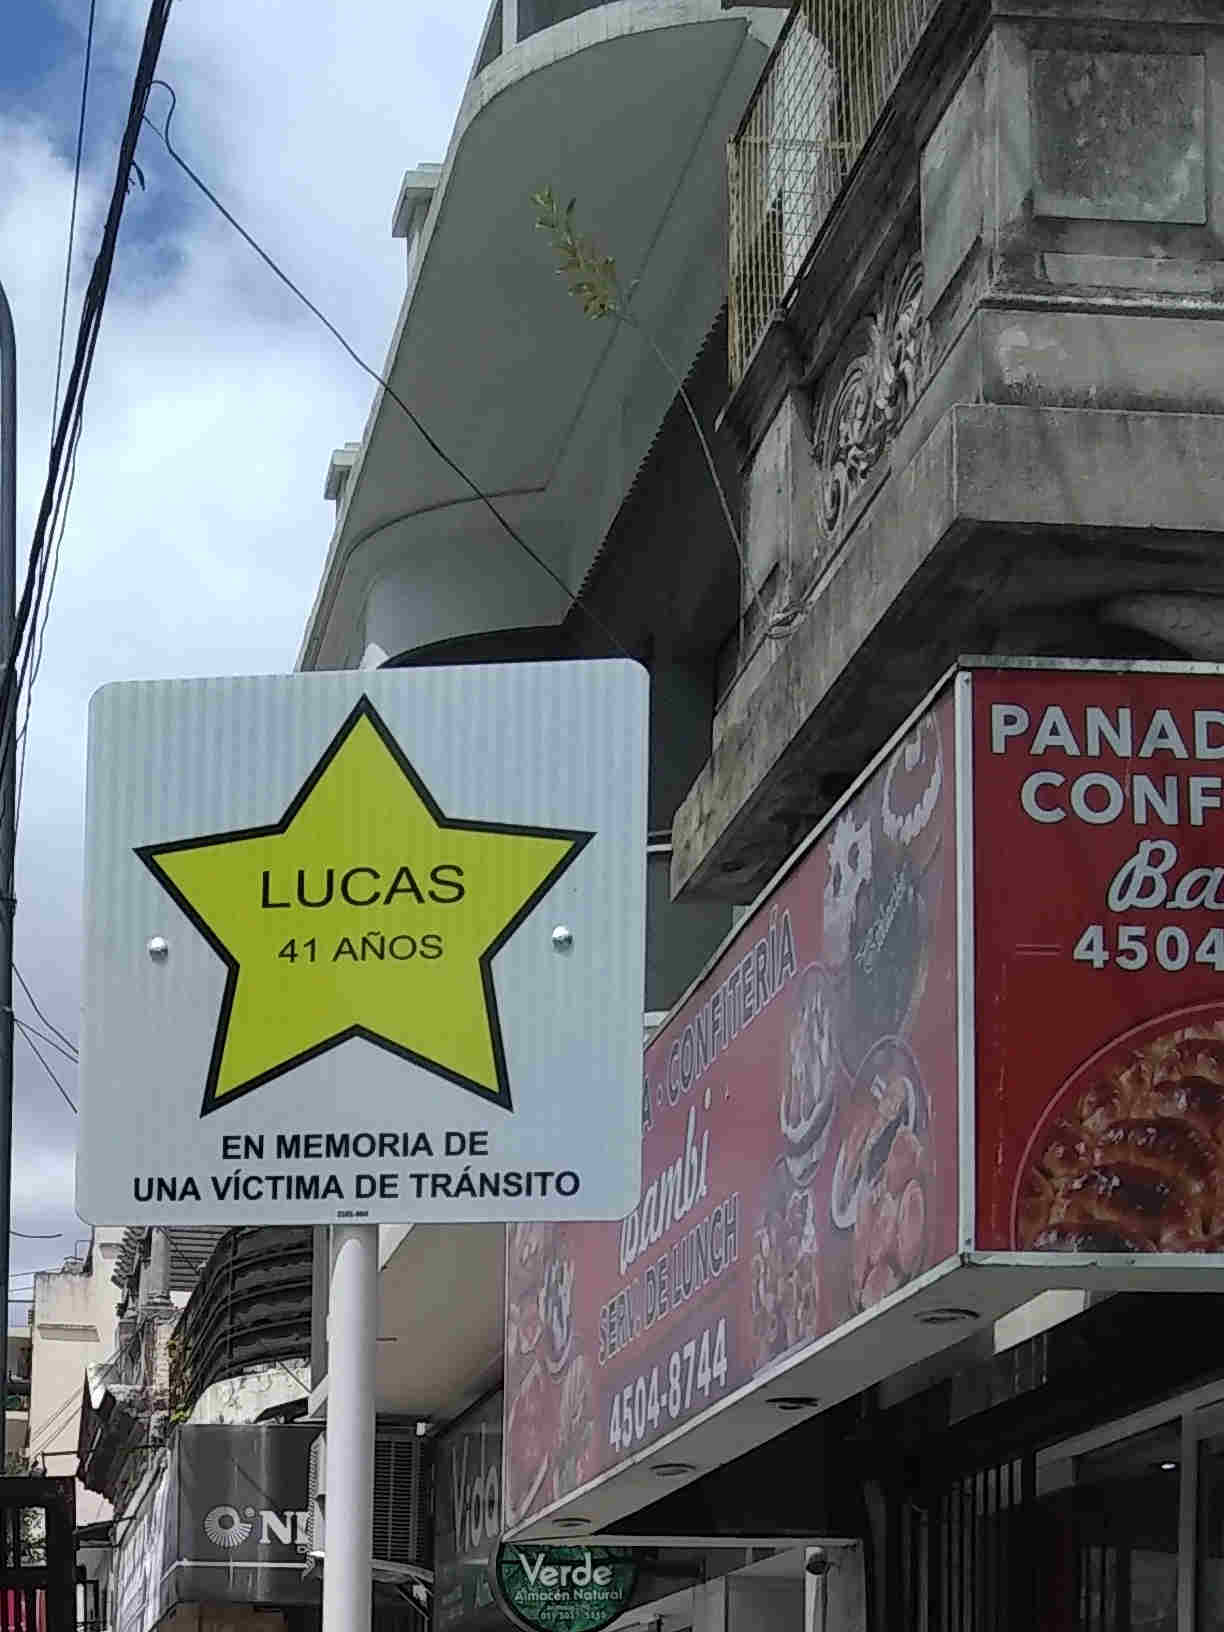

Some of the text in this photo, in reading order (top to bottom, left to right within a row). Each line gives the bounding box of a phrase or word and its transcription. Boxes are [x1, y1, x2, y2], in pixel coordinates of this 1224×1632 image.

[991, 703, 1224, 760] PANAD
[1021, 771, 1223, 826] CONF
[261, 863, 466, 909] LUCAS
[278, 931, 444, 963] 41 AÑOS
[664, 904, 799, 1108] CONFITERÍA
[221, 1131, 489, 1161] EN MEMORIA DE
[133, 1165, 581, 1202] UNA VÍCTIMA DE TRÁNSITO
[646, 1256, 669, 1330] DE
[670, 1191, 743, 1308] LUNCH
[608, 1316, 728, 1452] 4504-8744
[519, 1552, 612, 1587] Verde
[514, 1587, 623, 1602] Almacén Natural
